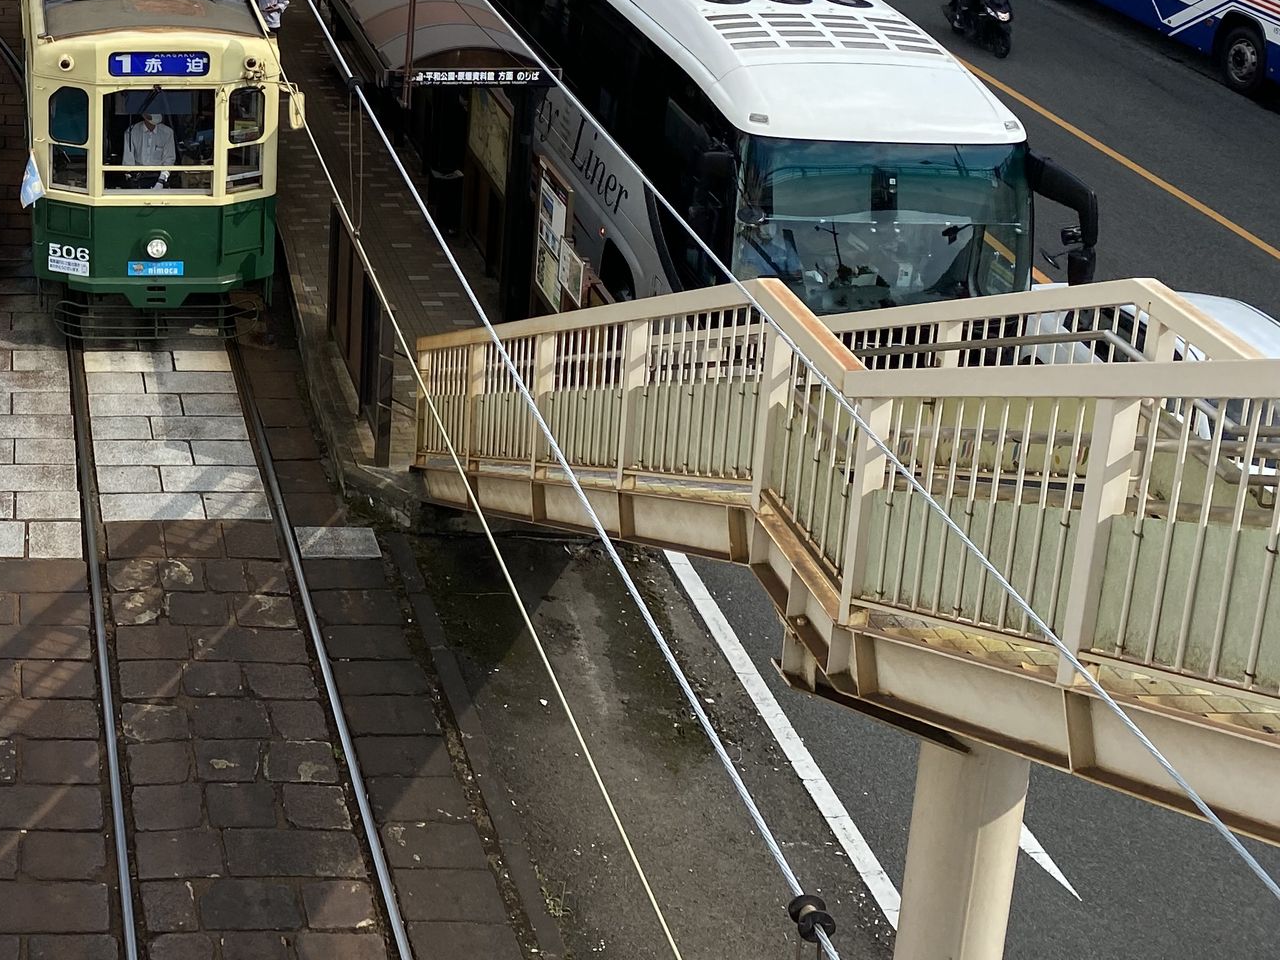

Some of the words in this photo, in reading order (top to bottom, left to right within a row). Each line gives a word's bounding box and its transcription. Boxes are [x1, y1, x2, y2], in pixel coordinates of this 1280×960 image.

[115, 54, 132, 73] 1
[498, 71, 514, 81] 方面
[517, 71, 540, 81] のりば
[570, 114, 629, 215] Liner
[48, 242, 90, 262] 506
[147, 265, 179, 275] nimoca
